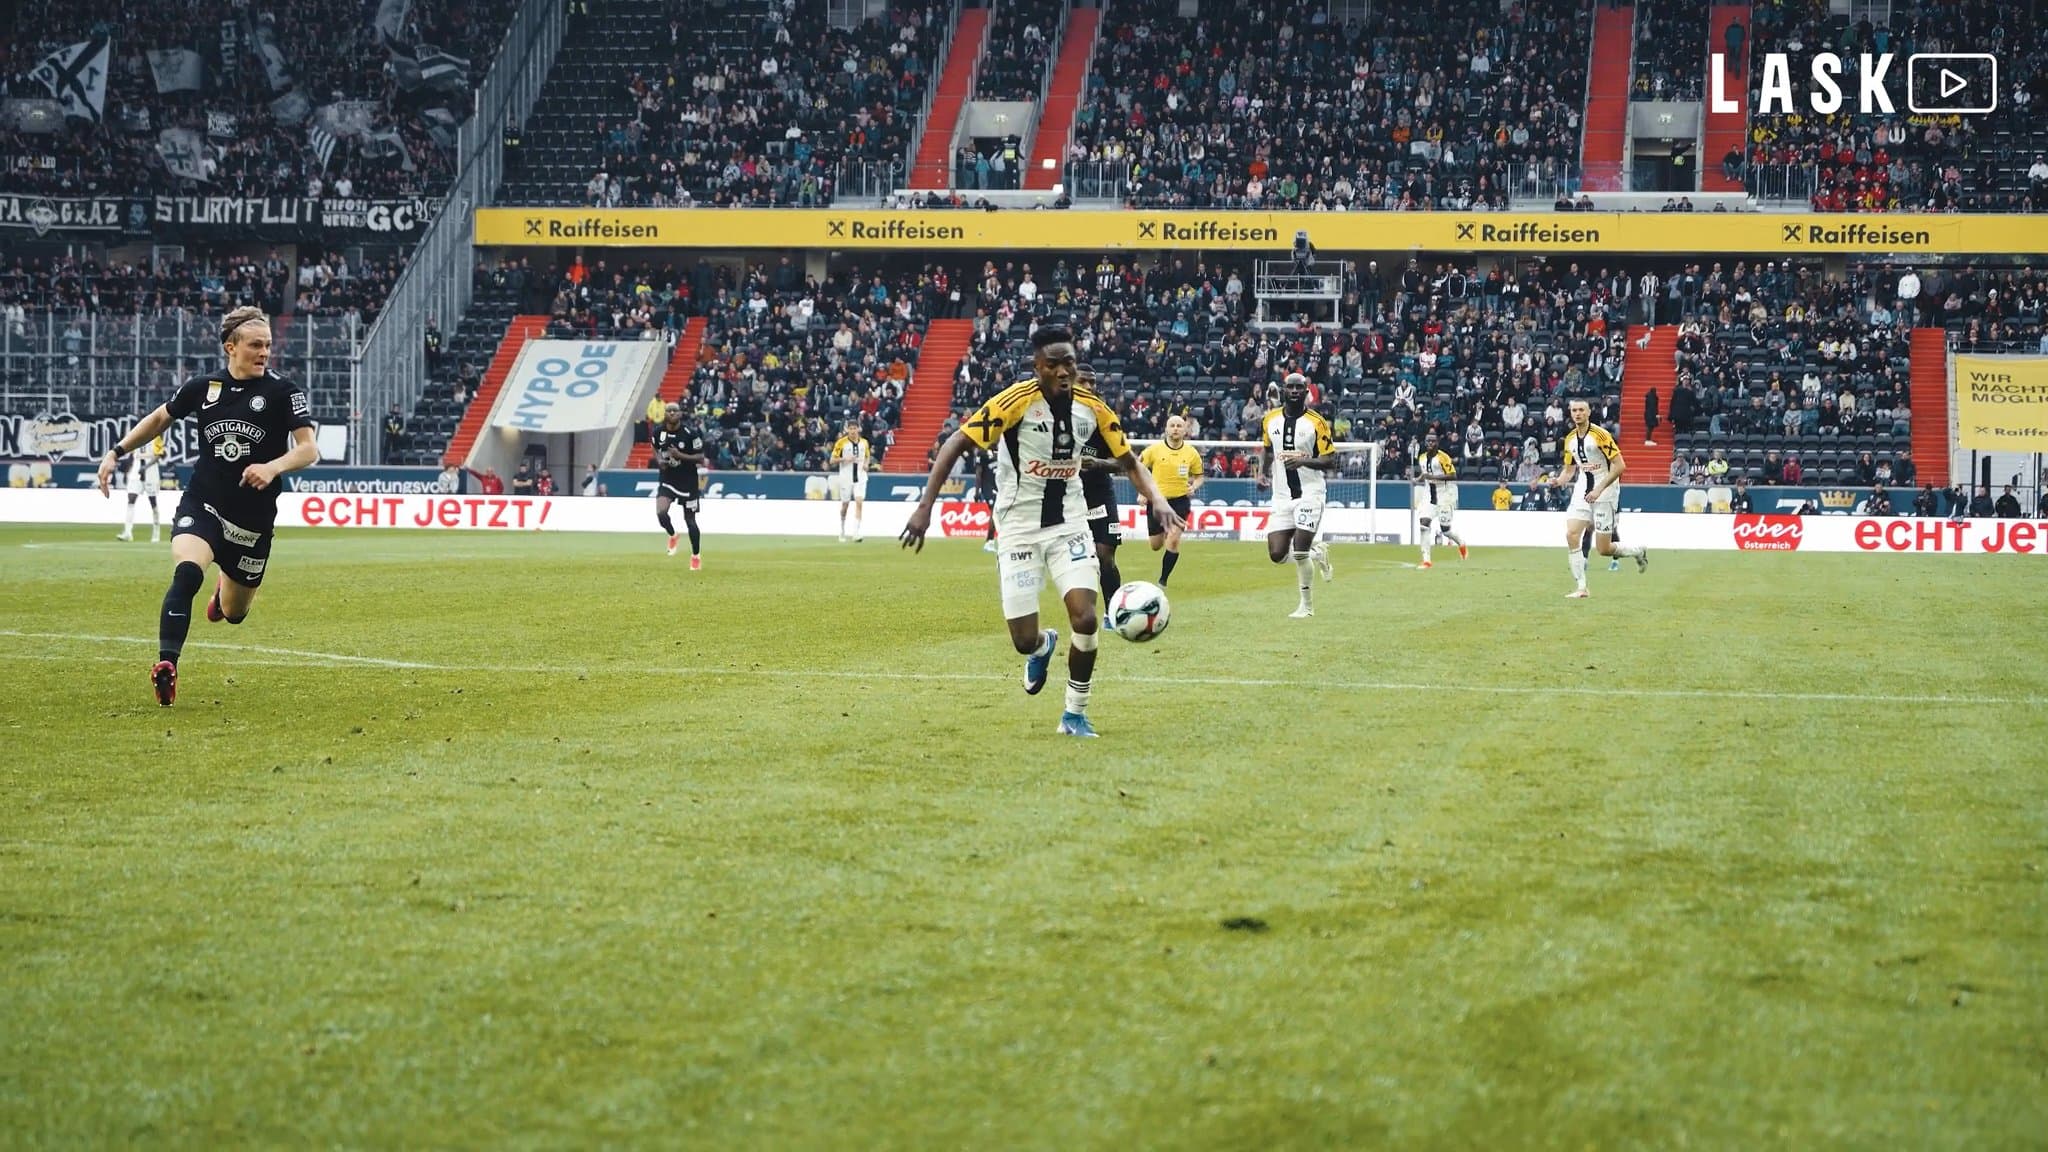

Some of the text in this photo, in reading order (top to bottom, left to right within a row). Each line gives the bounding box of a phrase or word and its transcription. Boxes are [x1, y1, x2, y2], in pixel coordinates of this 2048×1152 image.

[61, 201, 119, 225] GRAZ
[155, 195, 319, 224] STURMFLUT
[322, 199, 367, 211] TIFOSI
[367, 205, 415, 231] GC
[549, 218, 658, 238] Raiffeisen
[852, 219, 964, 240] Raiffeisen
[1163, 220, 1278, 241] Raiffeisen
[1482, 222, 1600, 243] Raiffeisen
[1809, 223, 1930, 245] Raiffeisen
[1970, 371, 2011, 383] WIR
[509, 357, 571, 429] HYPO
[205, 421, 262, 441] PUNTIGAMER
[1732, 515, 1804, 538] ober
[1010, 551, 1033, 561] BWT
[1744, 541, 1791, 550] österreich
